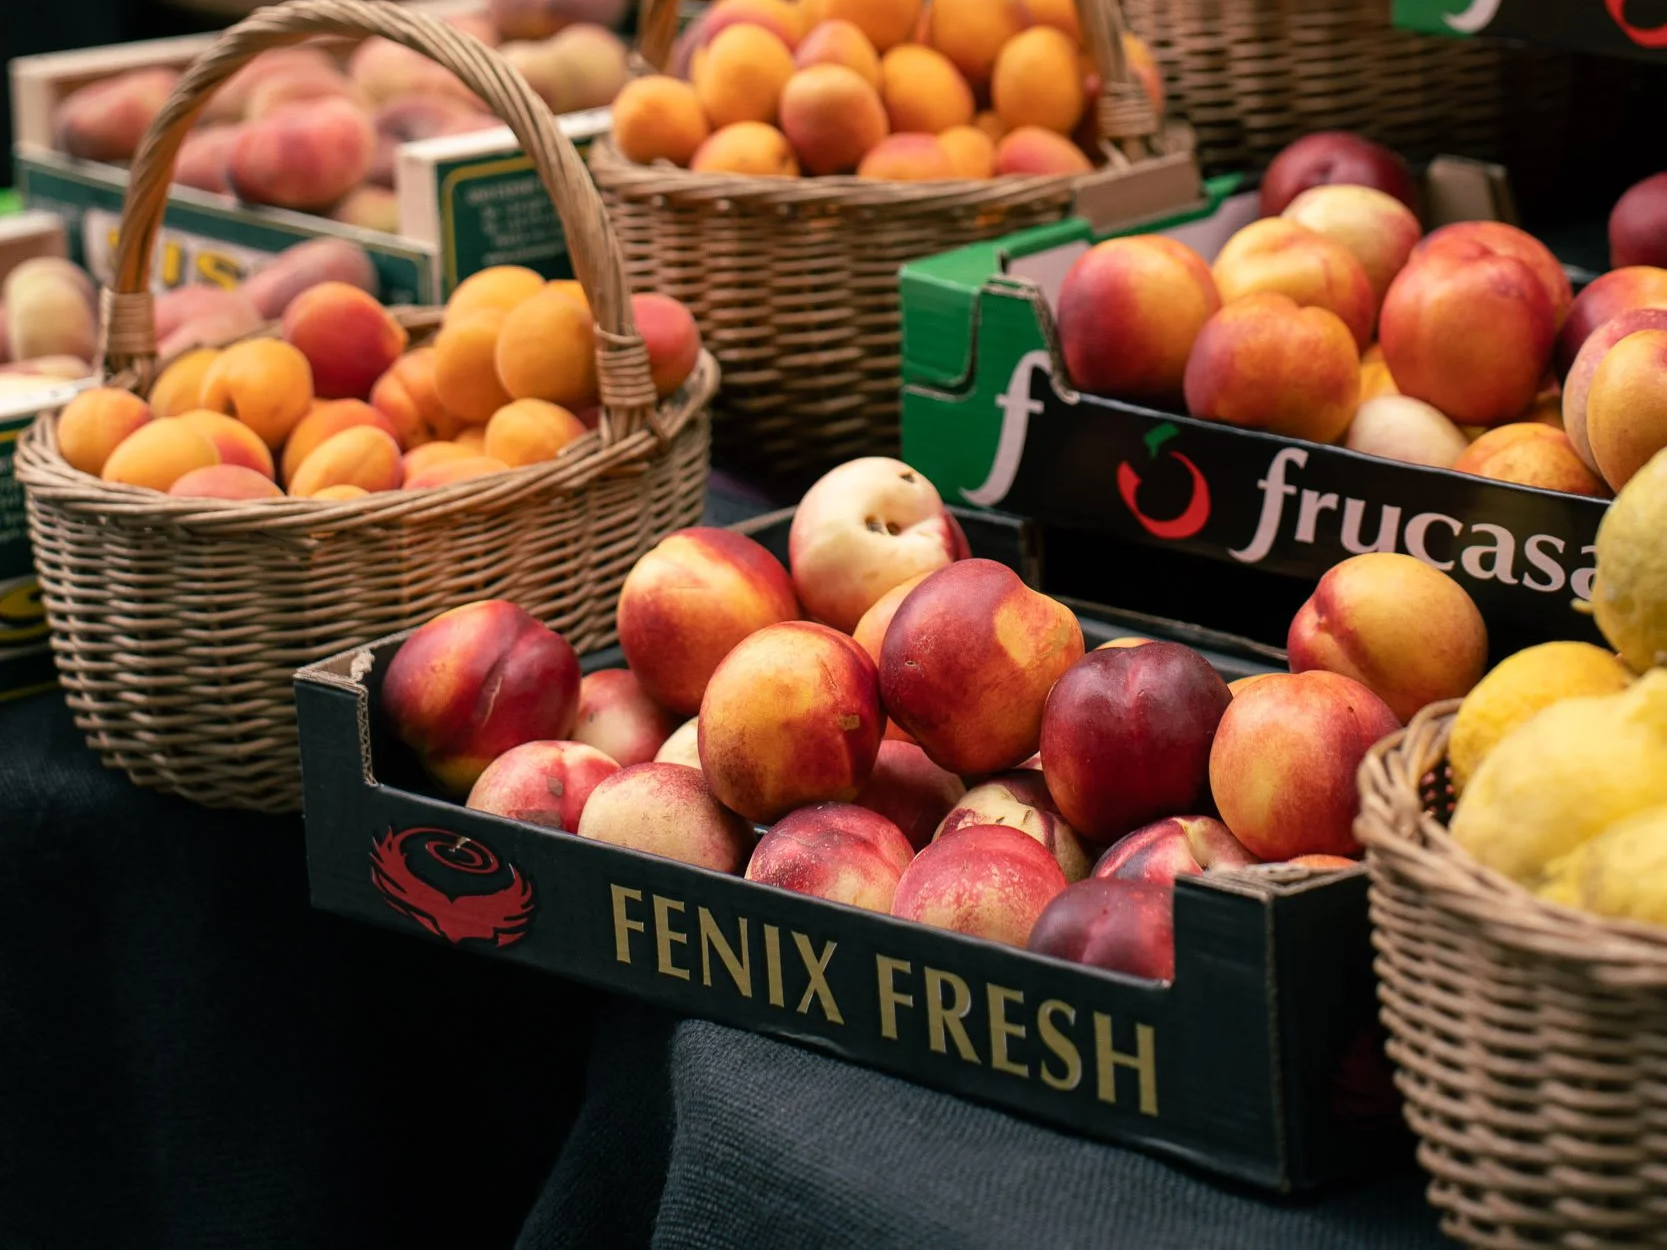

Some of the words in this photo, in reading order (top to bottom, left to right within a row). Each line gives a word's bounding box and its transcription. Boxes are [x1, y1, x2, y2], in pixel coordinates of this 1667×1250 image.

[958, 350, 1053, 507] f
[610, 883, 844, 1026] FENIX
[876, 953, 1159, 1117] FRESH
